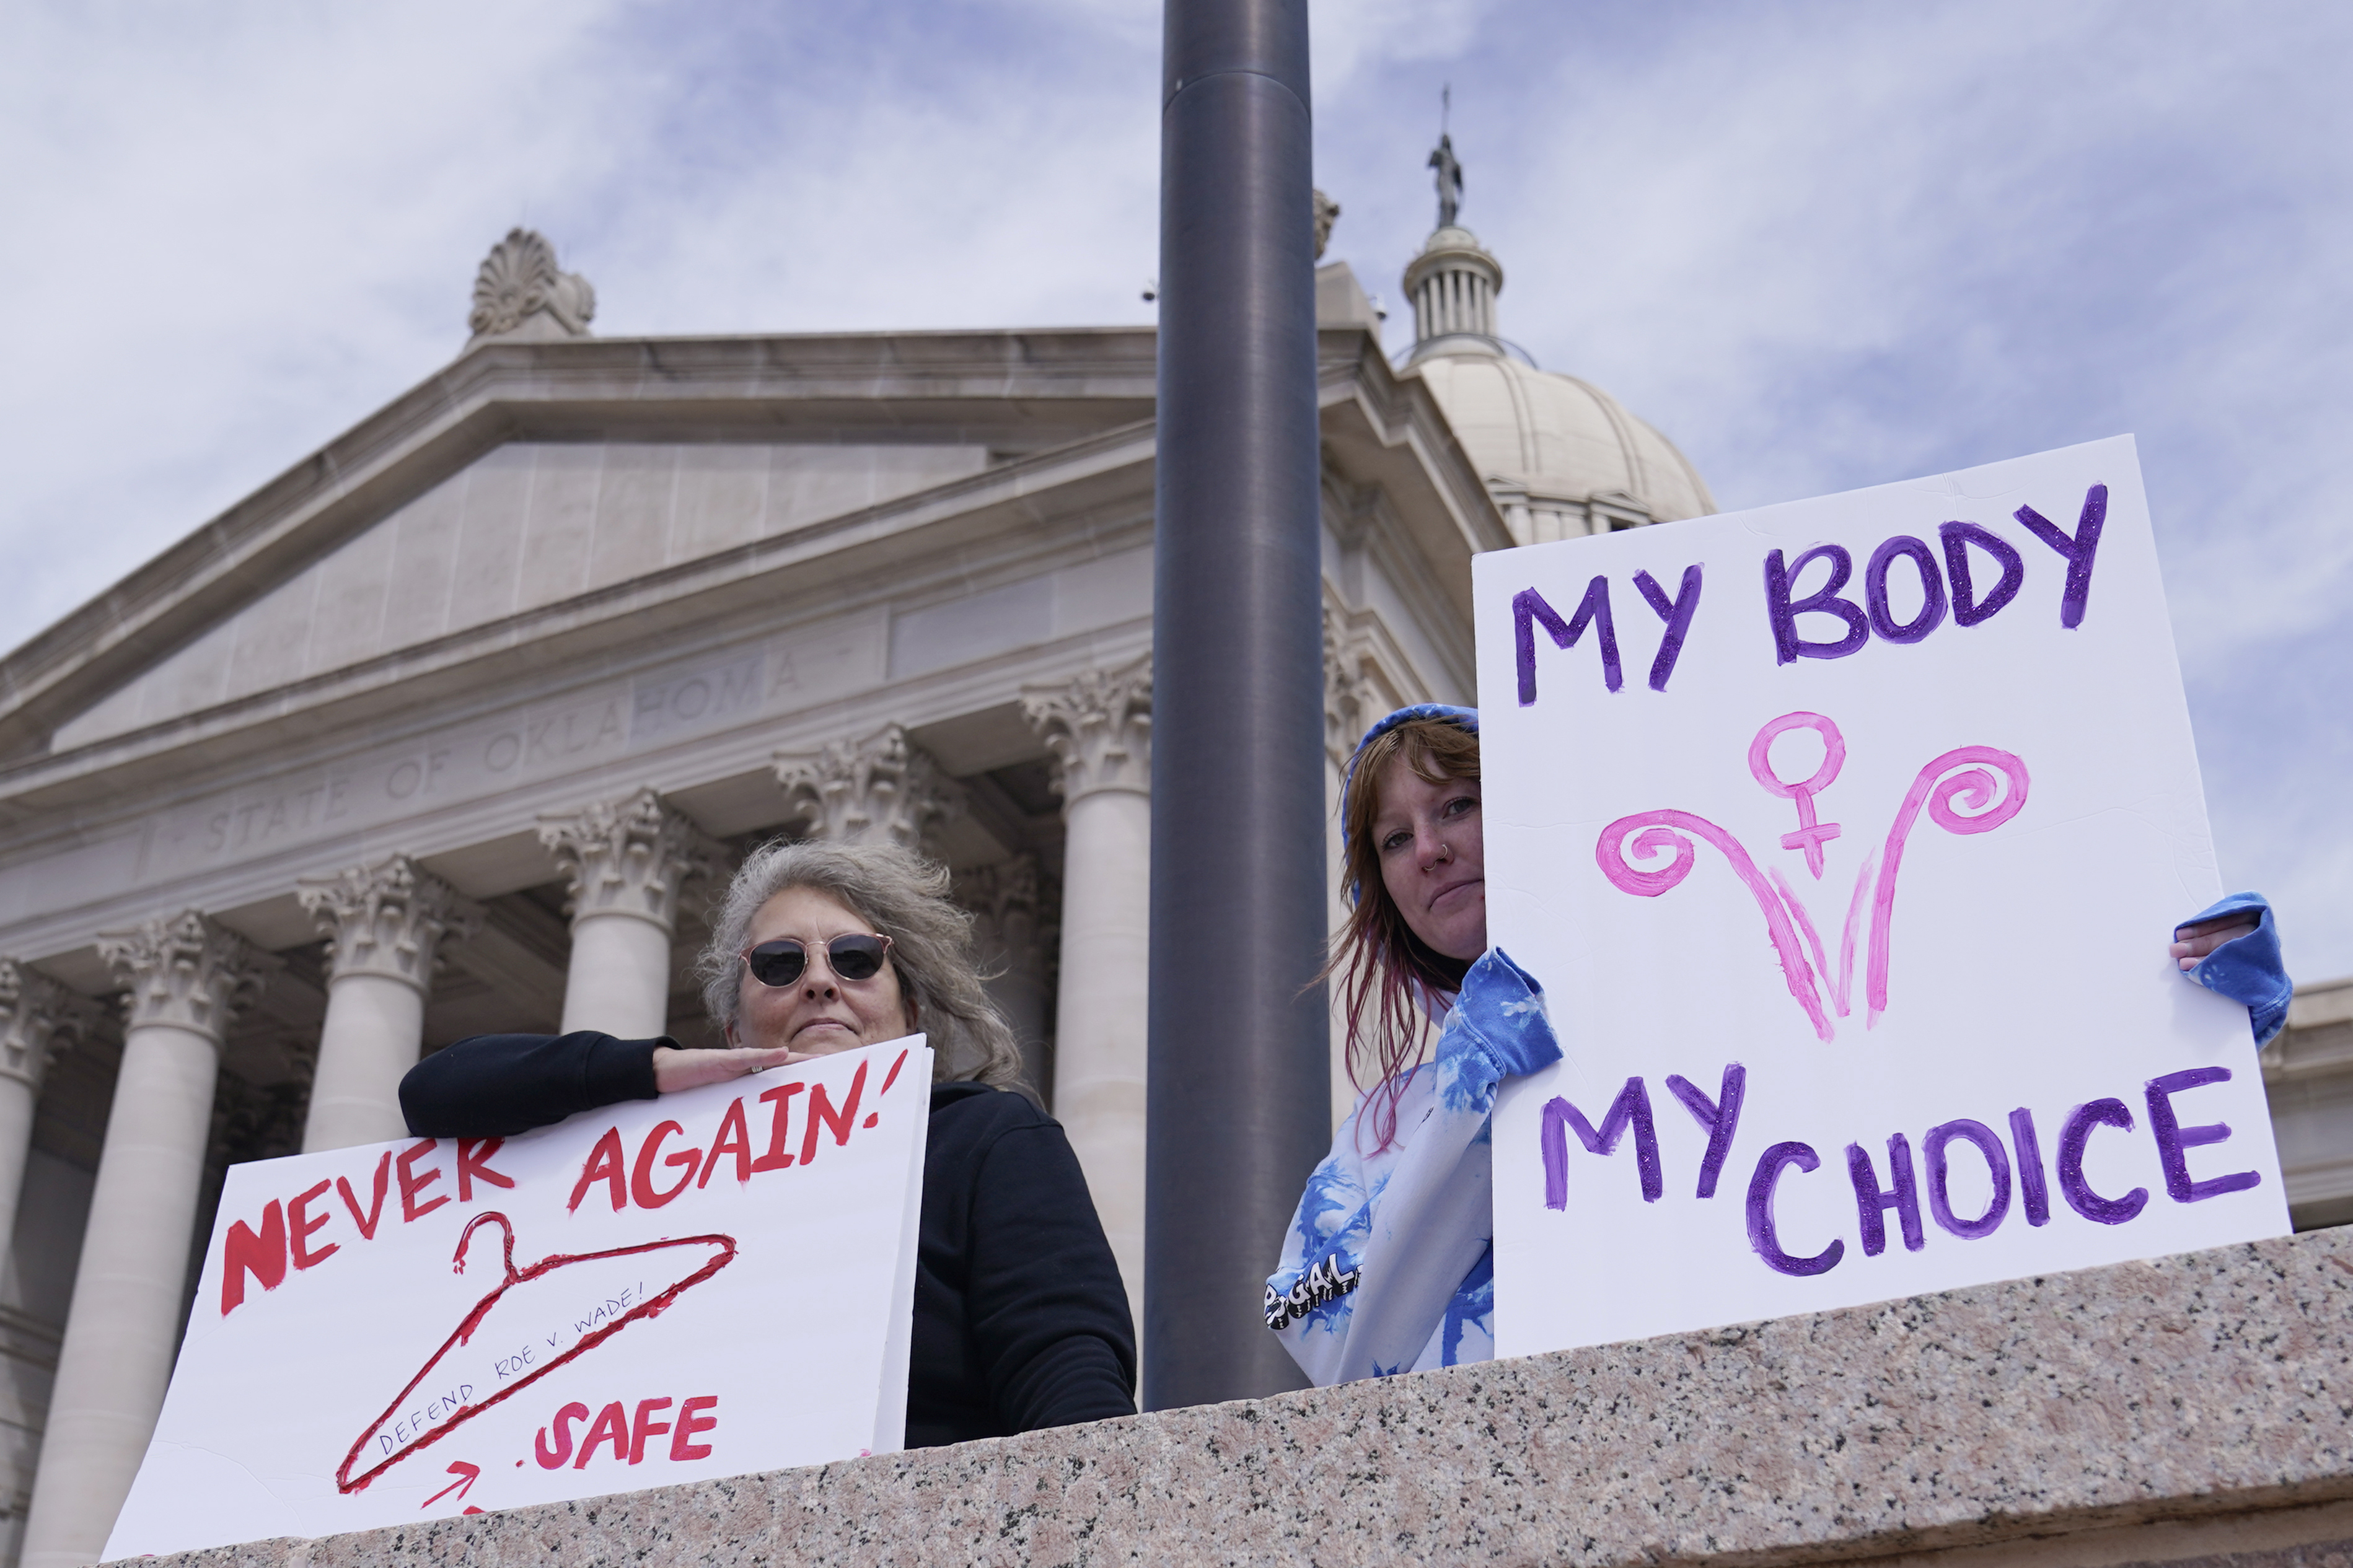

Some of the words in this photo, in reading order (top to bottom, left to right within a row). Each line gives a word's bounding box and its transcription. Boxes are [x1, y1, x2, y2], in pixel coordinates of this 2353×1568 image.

[1511, 563, 1704, 707] MY
[1763, 481, 2108, 667] BODY
[205, 777, 349, 854] STATE
[385, 748, 451, 800] OF
[483, 650, 804, 774] OKLAHOMA
[221, 1136, 515, 1318] NEVER
[567, 1048, 909, 1214] AGAIN!
[1539, 1062, 1746, 1212] MY
[1746, 1066, 2262, 1277] CHOICE
[379, 1384, 473, 1455] DEFEND
[495, 1345, 536, 1380] ROE
[547, 1331, 563, 1347] V.
[574, 1281, 643, 1333] WADE!
[535, 1395, 719, 1470] SAFE
